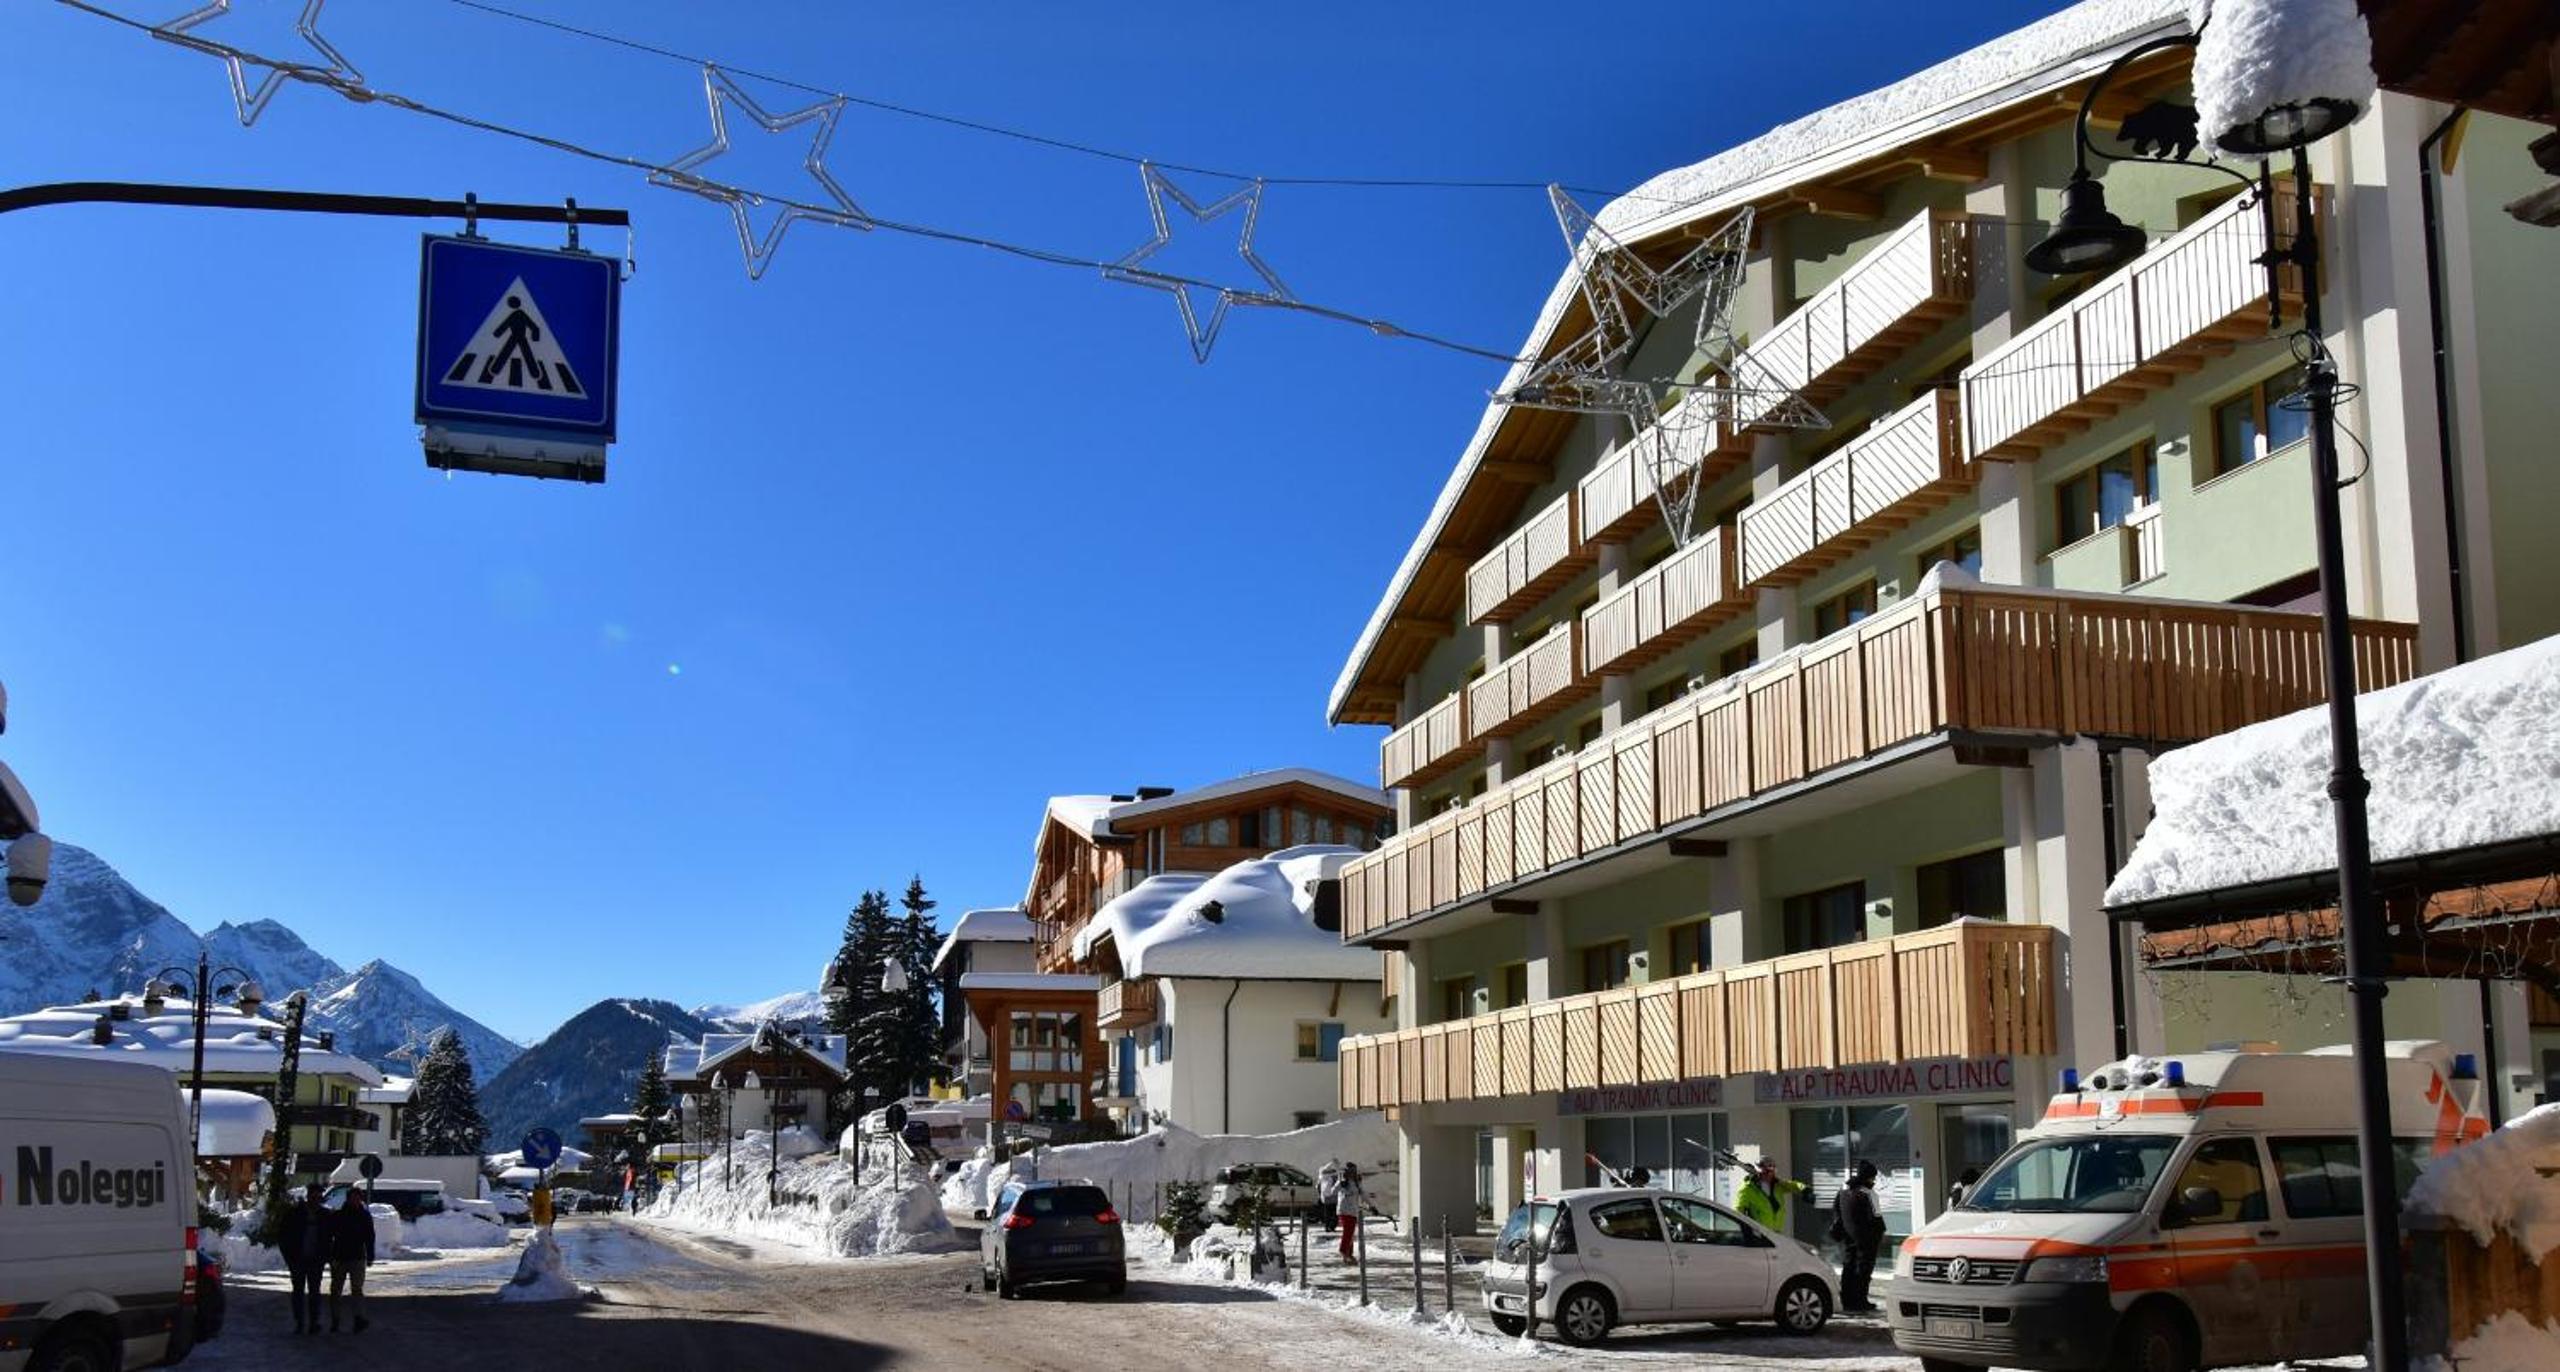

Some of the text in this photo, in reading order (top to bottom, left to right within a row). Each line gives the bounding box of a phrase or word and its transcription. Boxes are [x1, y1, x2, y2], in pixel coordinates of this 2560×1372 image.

[1573, 1082, 1718, 1112] ALP TRAUMA CLINIC
[1780, 1060, 2011, 1099] ALP TRAUMA CLINIC
[17, 1146, 165, 1209] Noleggi
